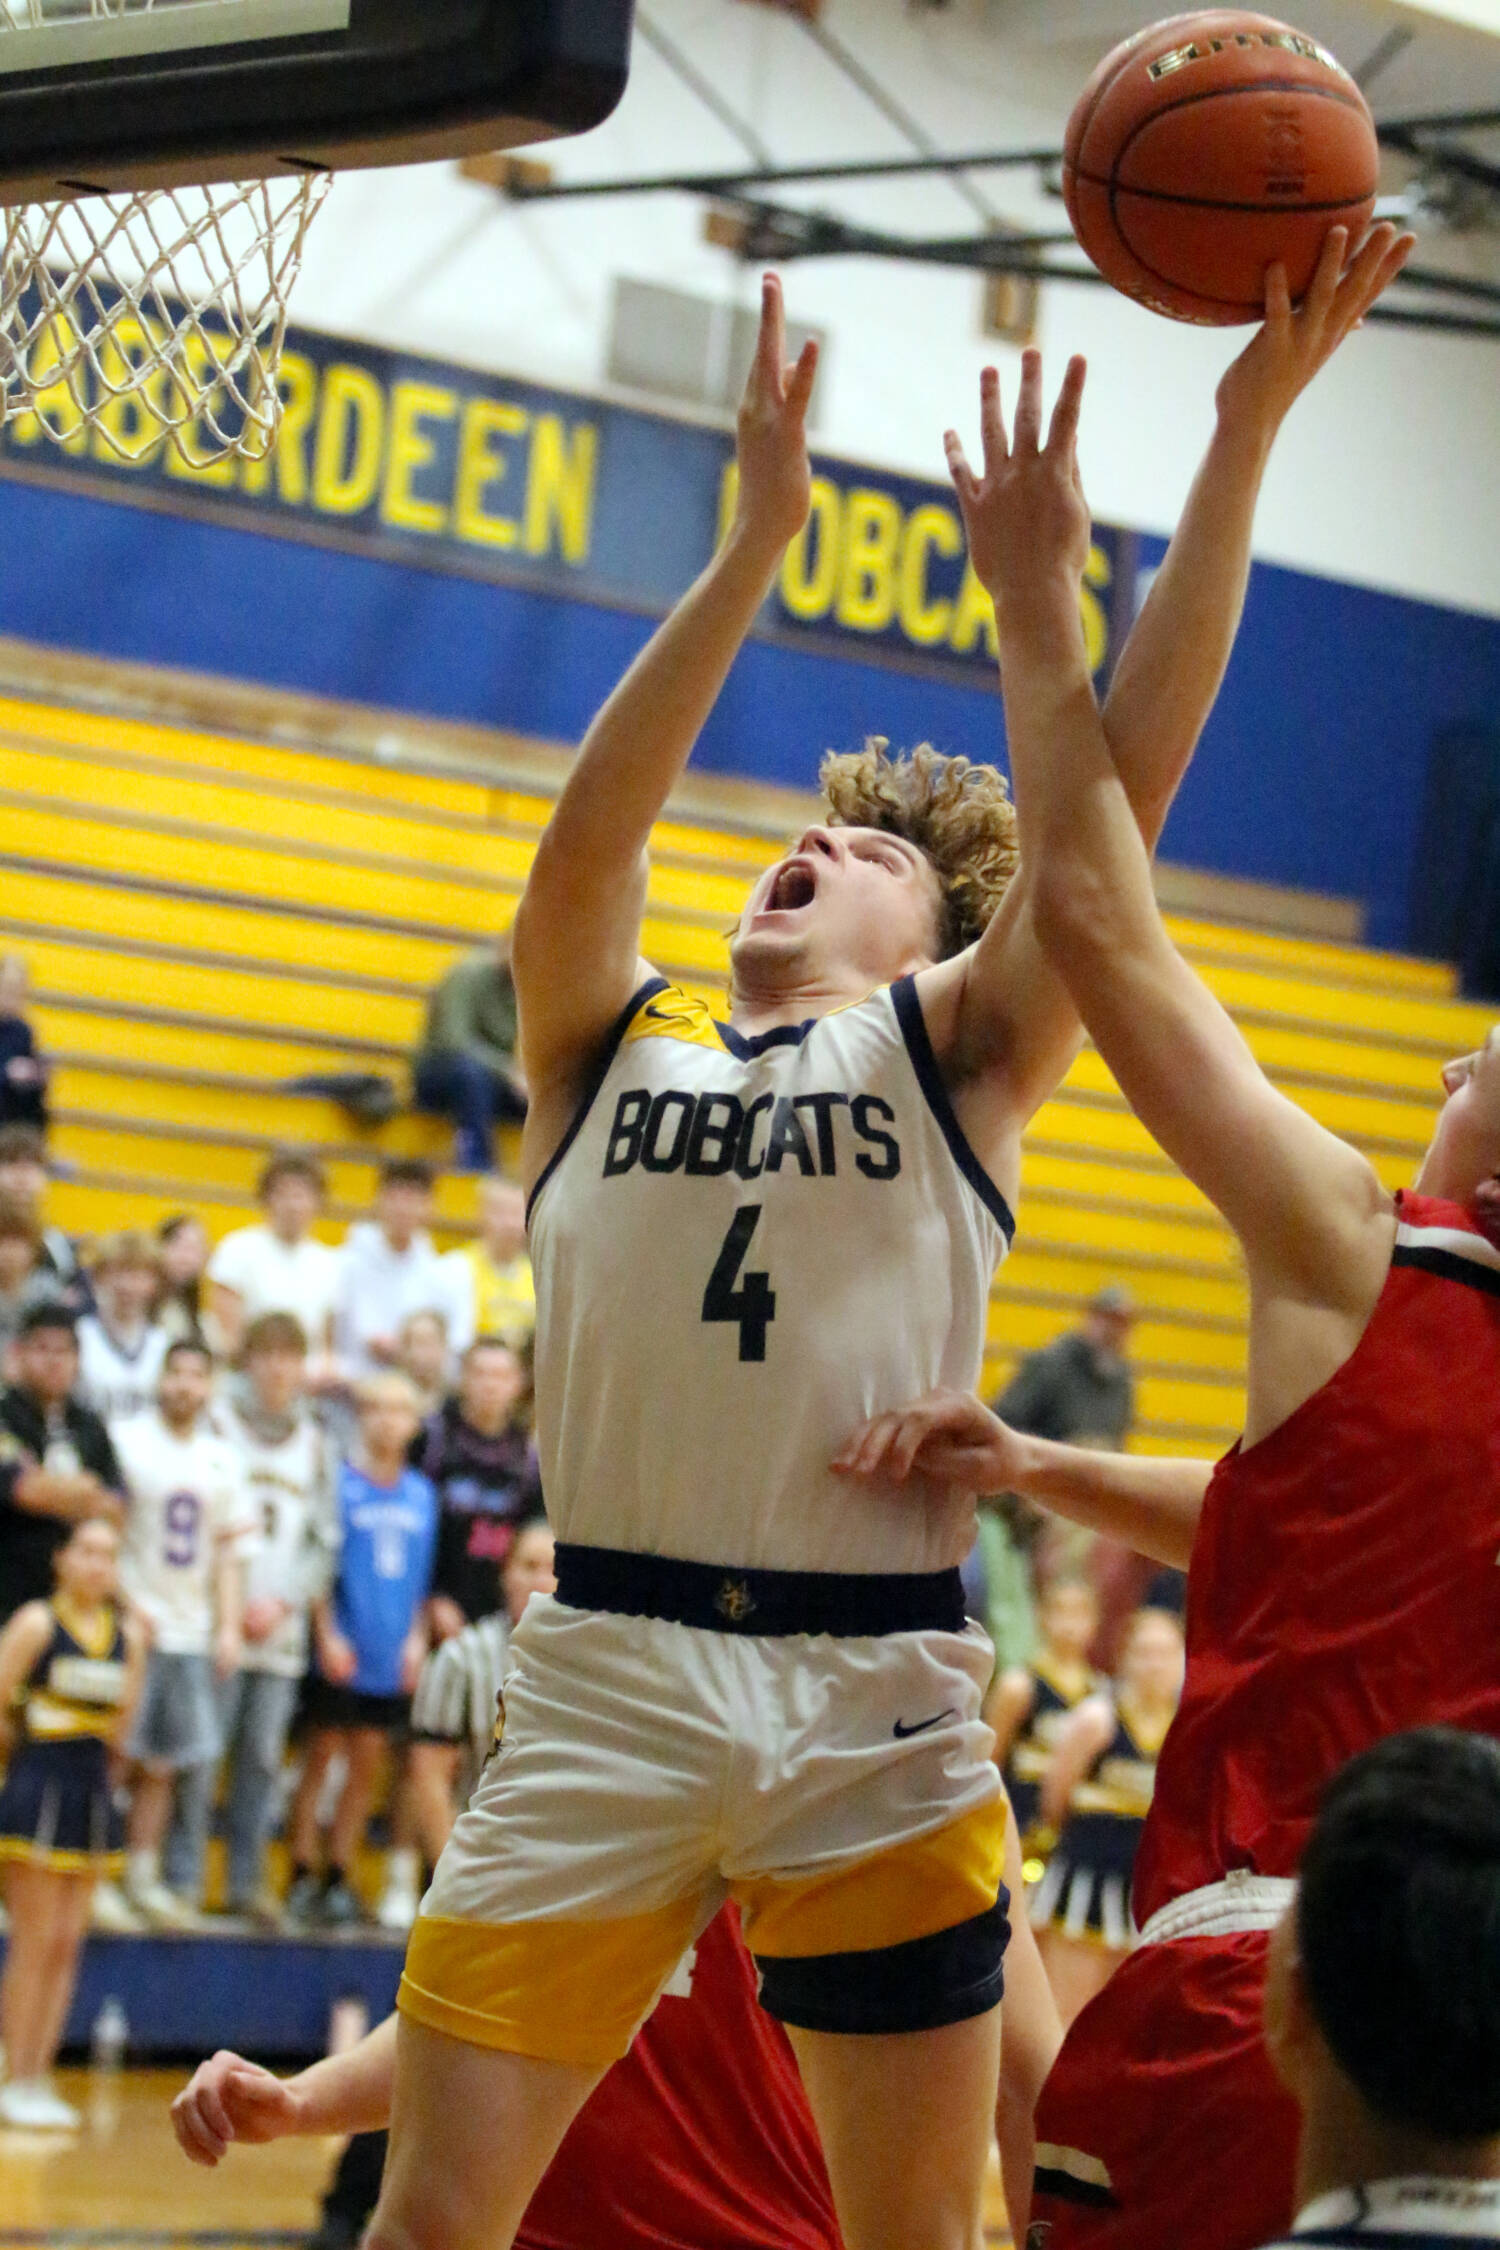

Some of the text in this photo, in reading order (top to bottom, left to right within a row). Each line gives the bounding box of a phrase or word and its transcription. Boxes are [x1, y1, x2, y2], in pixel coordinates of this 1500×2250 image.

[10, 306, 1111, 673] ABERDEEN OBCAS
[602, 1088, 901, 1181] BOBCATS
[701, 1204, 776, 1362] 4
